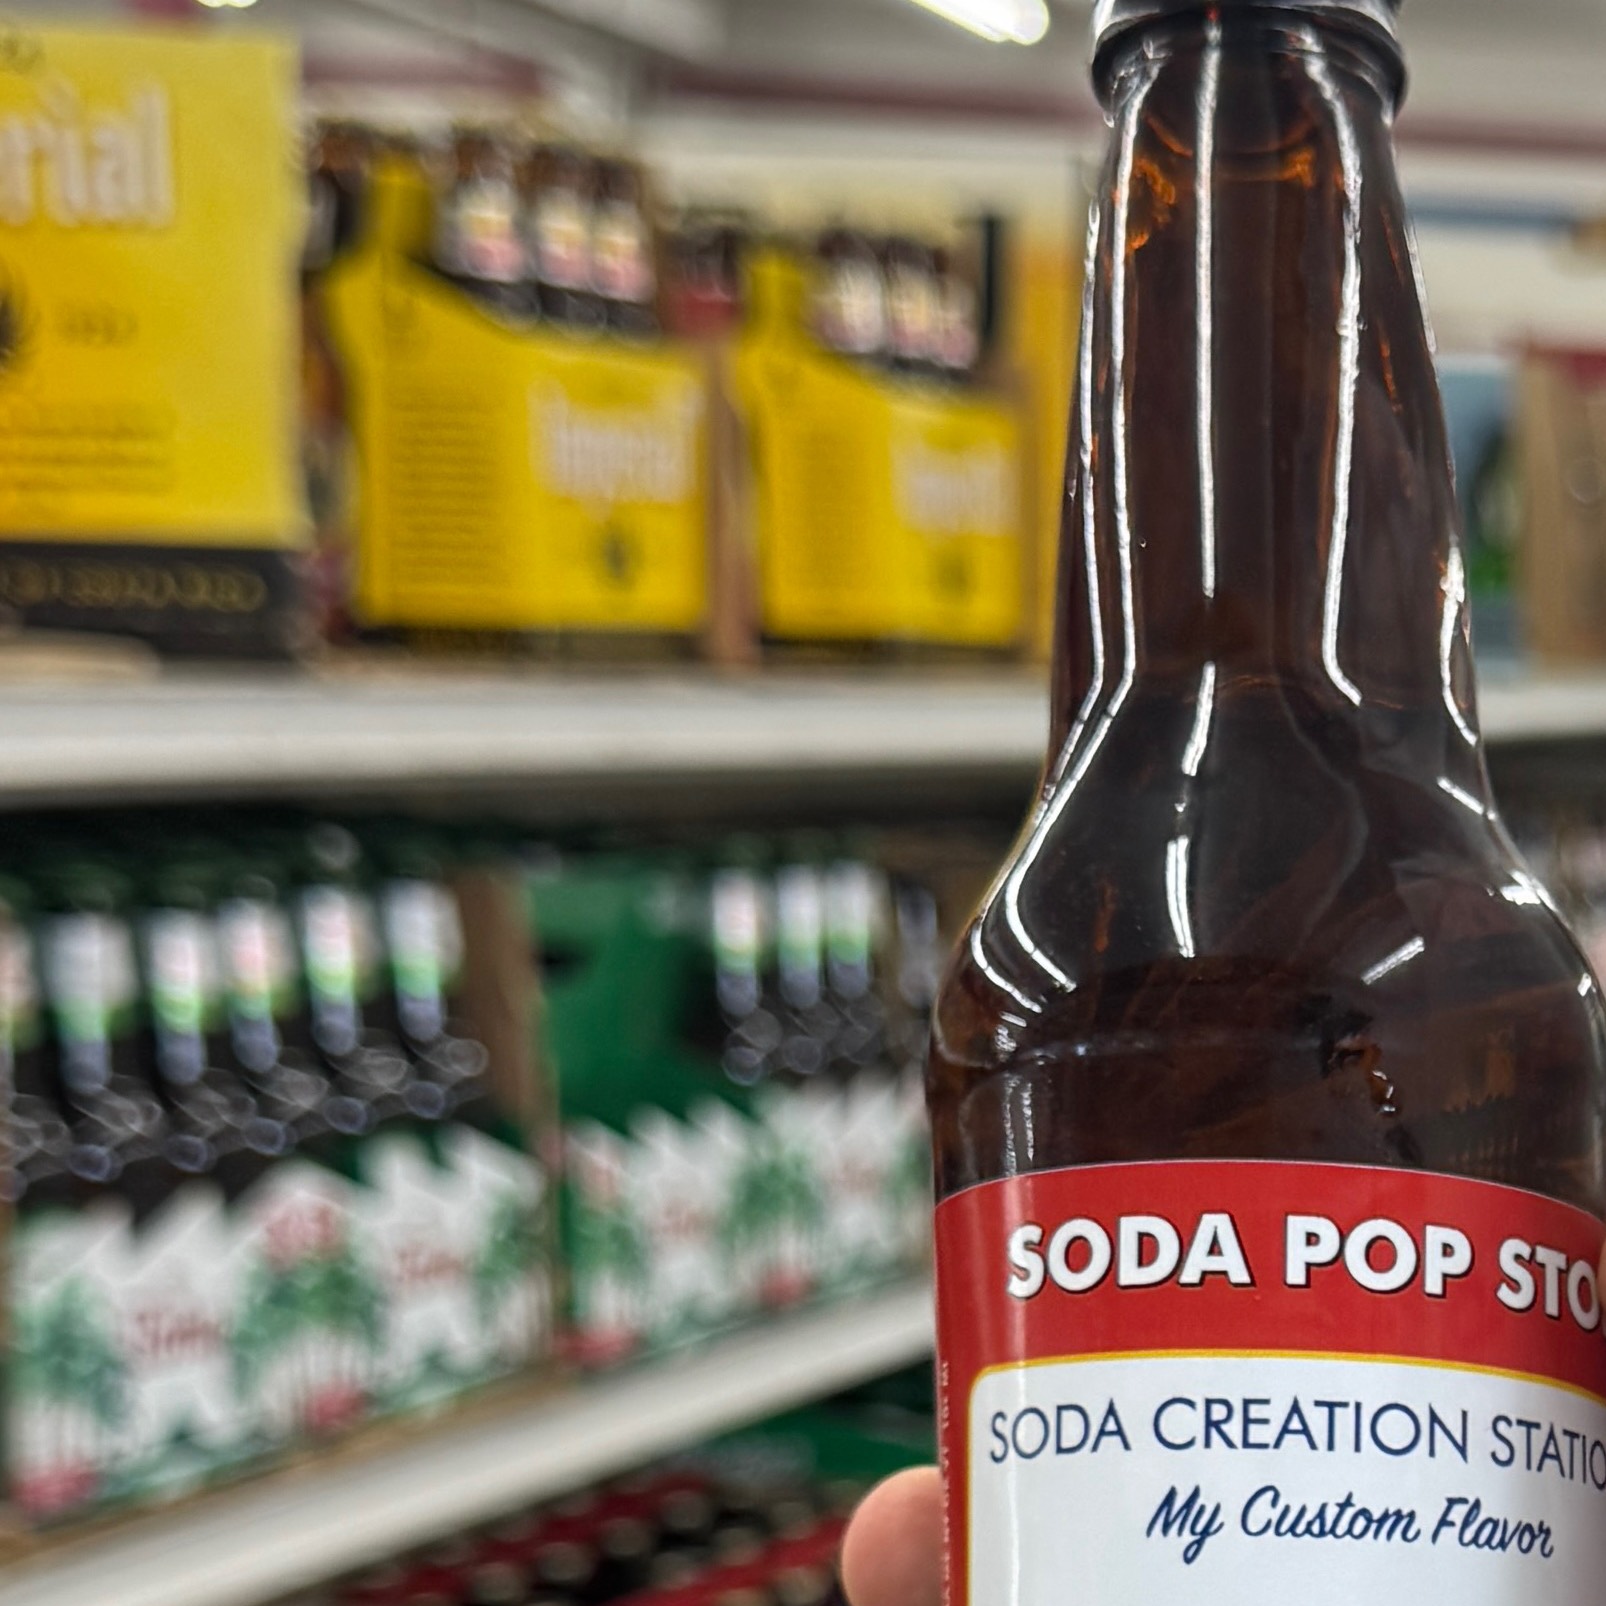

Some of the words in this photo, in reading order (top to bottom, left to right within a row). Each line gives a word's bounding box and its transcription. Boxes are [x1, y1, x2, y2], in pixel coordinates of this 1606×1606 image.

[1006, 1213, 1256, 1301] SODA
[1285, 1214, 1474, 1297] POP
[989, 1396, 1132, 1464] SODA
[1152, 1396, 1469, 1464] CREATION
[1146, 1485, 1224, 1565] My
[1240, 1485, 1421, 1546] Custom
[1430, 1496, 1555, 1560] Flavor
